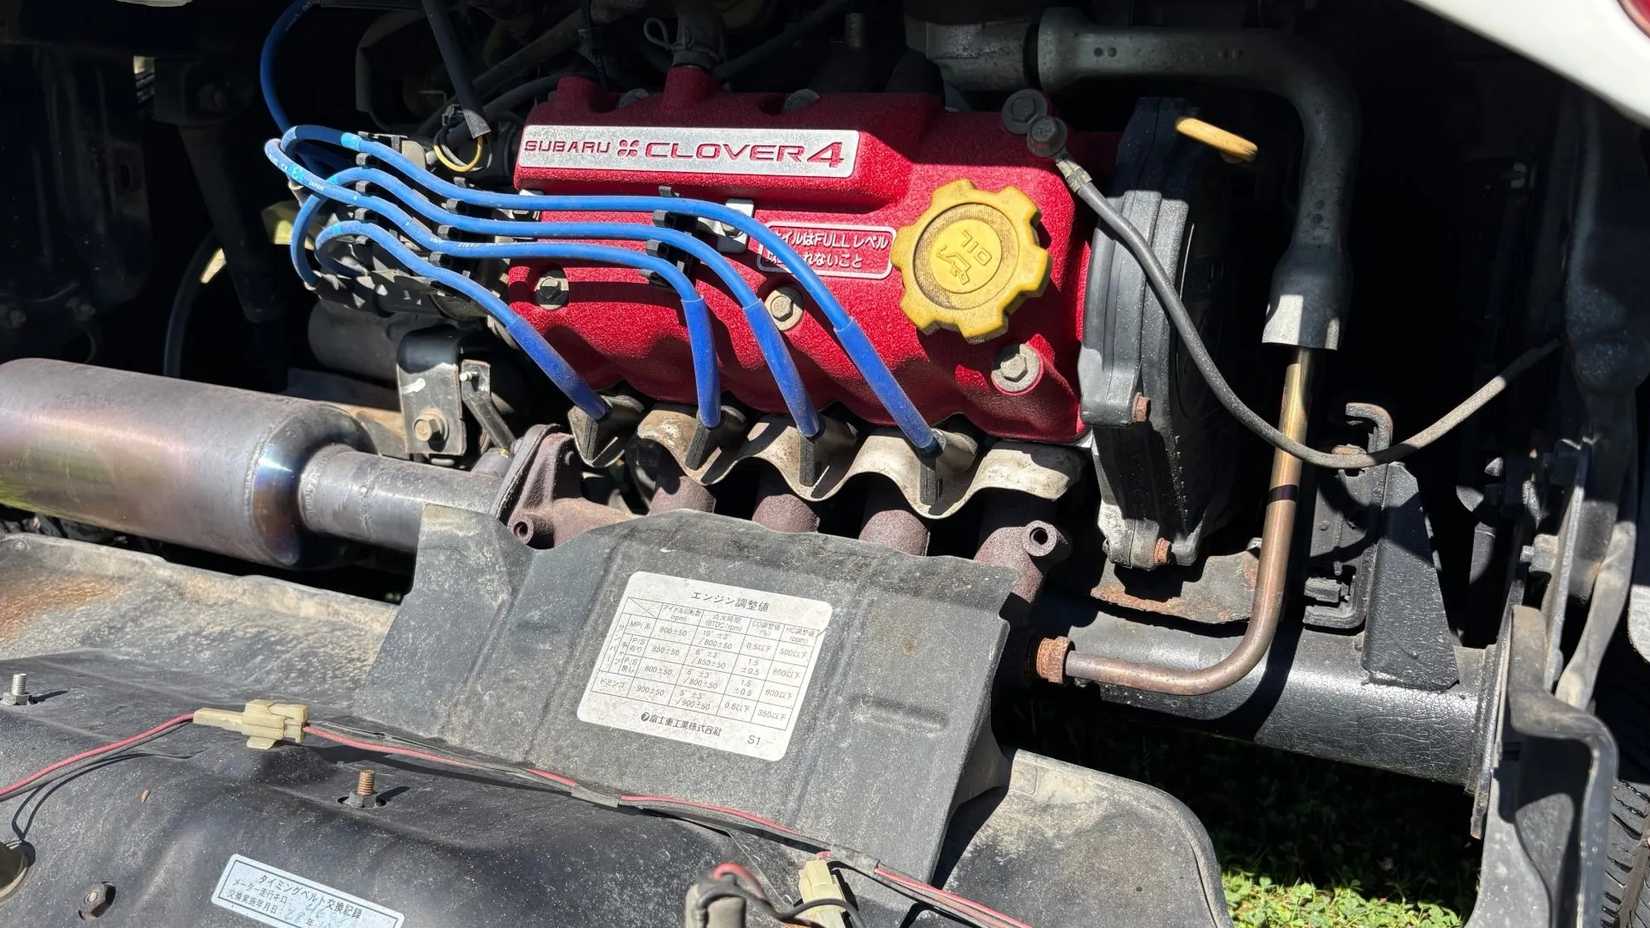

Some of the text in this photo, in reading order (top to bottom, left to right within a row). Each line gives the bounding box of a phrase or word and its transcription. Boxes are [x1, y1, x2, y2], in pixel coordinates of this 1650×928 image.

[524, 139, 611, 154] SUBARU
[961, 229, 994, 267] OIL
[691, 591, 769, 613] エンジン調整値
[747, 734, 761, 746] S1
